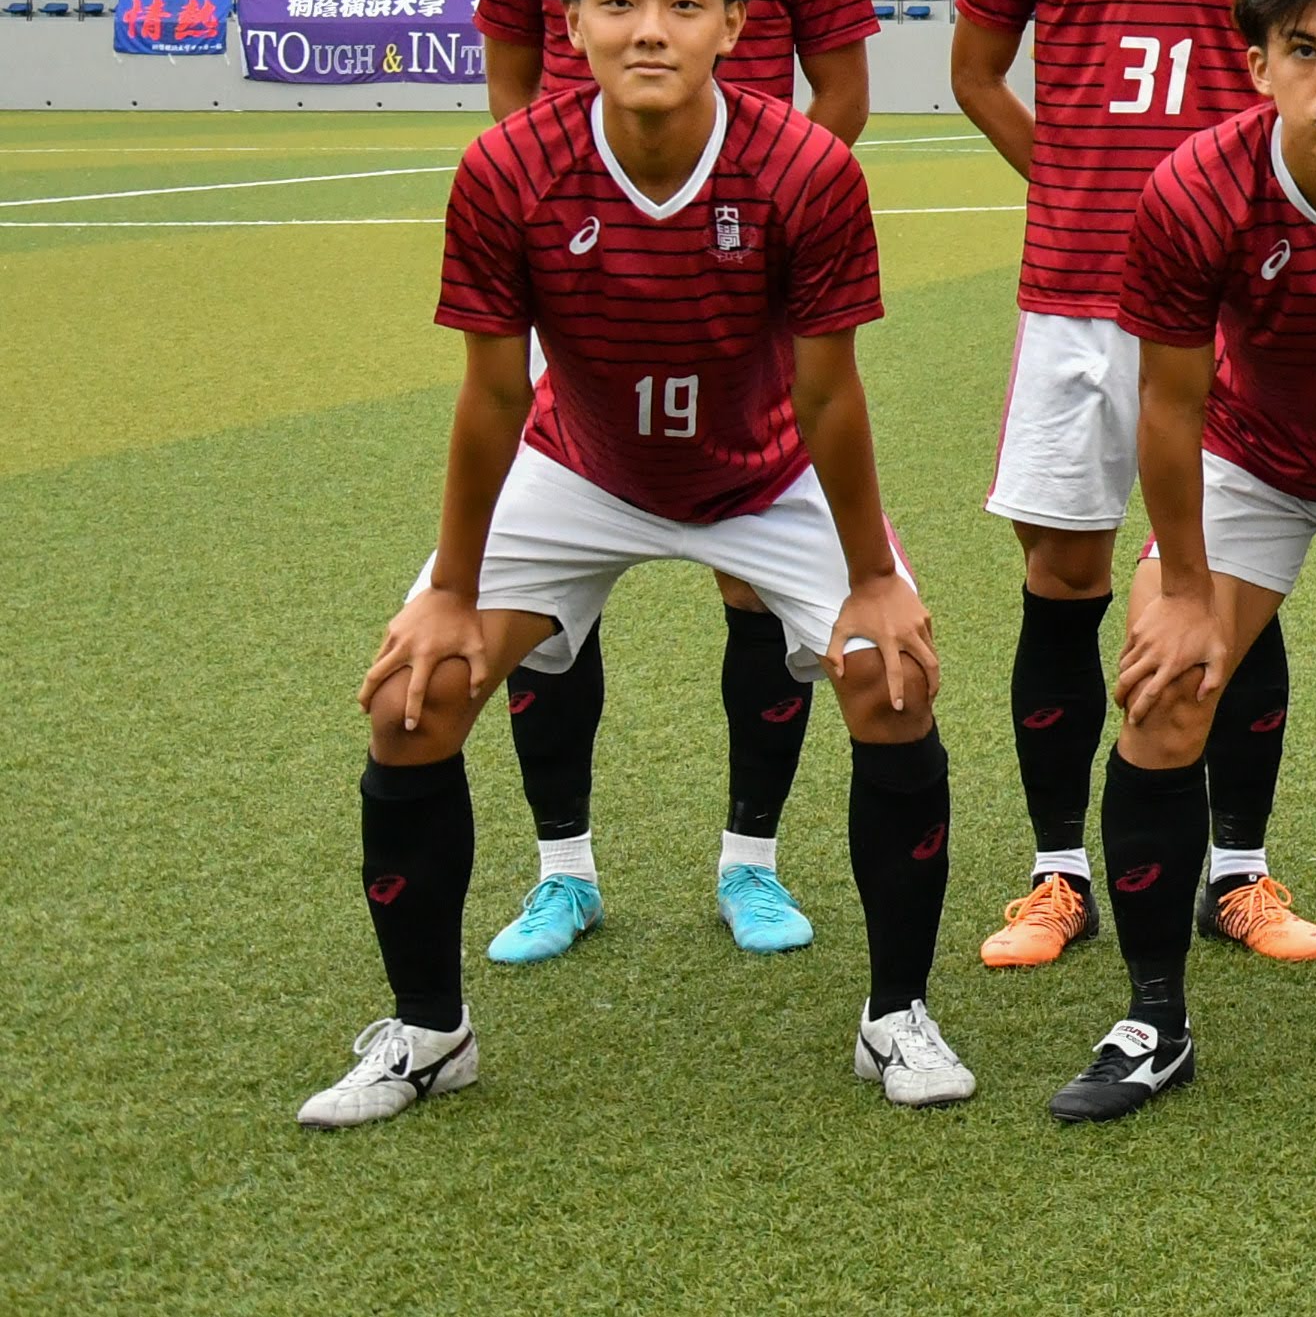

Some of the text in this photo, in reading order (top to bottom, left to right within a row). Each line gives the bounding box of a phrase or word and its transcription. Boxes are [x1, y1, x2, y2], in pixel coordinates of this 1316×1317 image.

[382, 43, 404, 73] &
[1108, 35, 1193, 115] 31
[635, 374, 699, 438] 19
